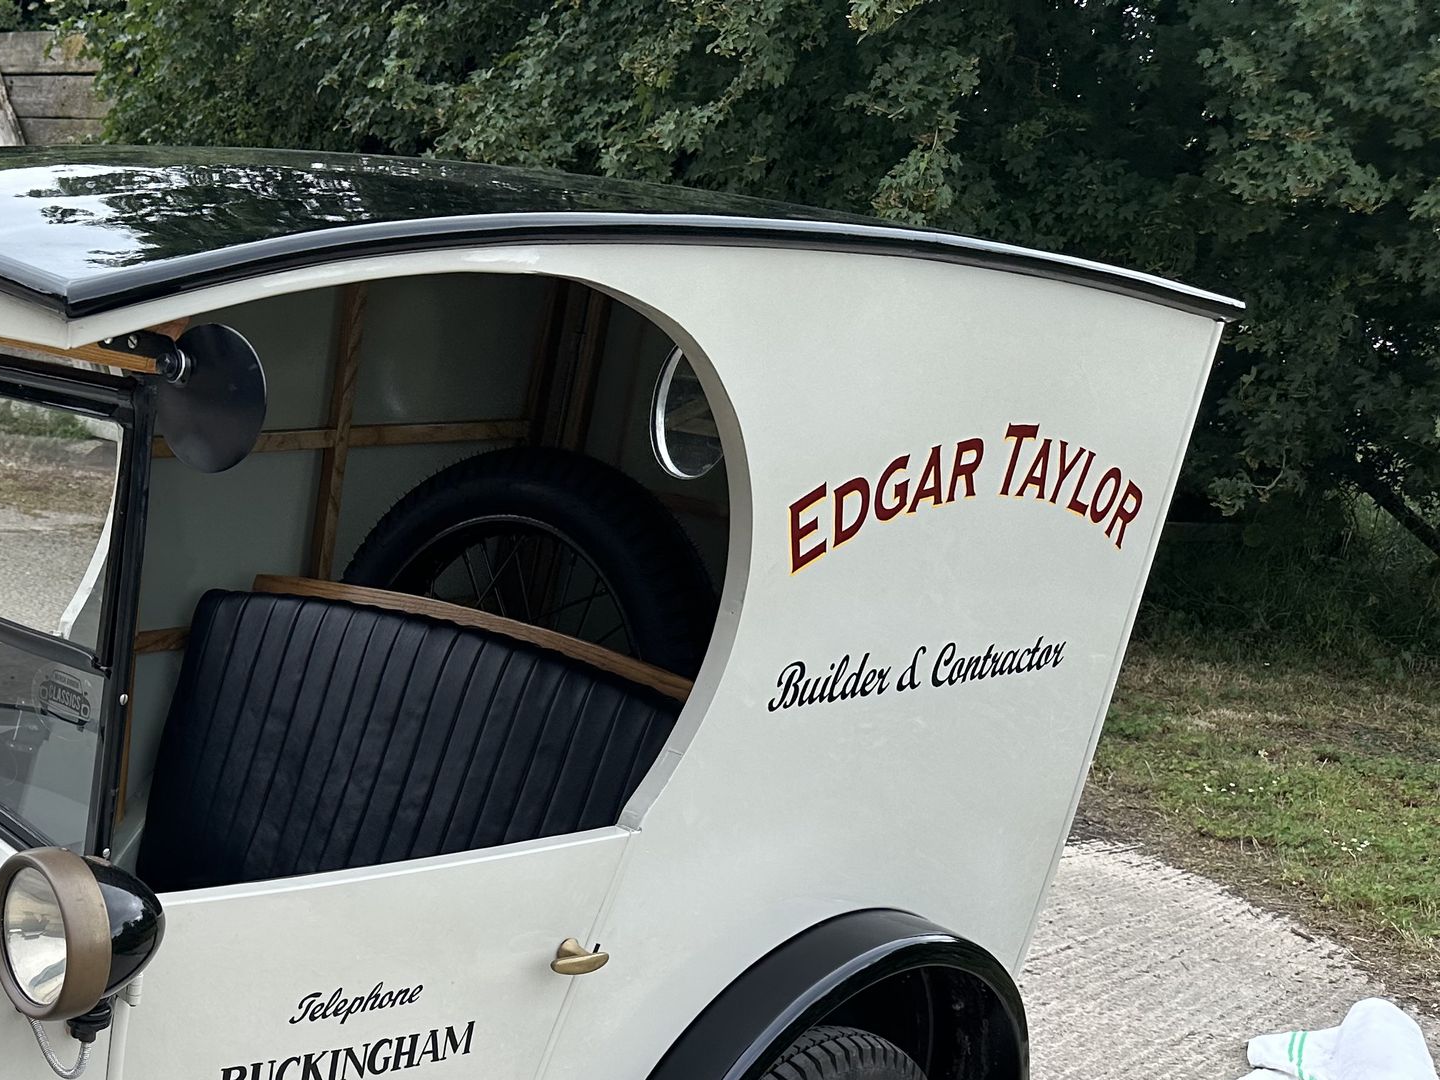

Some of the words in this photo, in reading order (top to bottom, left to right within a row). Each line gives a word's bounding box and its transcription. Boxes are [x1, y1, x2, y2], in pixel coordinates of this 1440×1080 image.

[788, 437, 985, 576] EDGAR
[999, 422, 1144, 550] TAYLOR
[49, 684, 81, 710] CLASSICS
[767, 652, 891, 712] Builder
[896, 645, 927, 692] &
[931, 635, 1067, 688] Contractor
[288, 981, 424, 1025] Telephone
